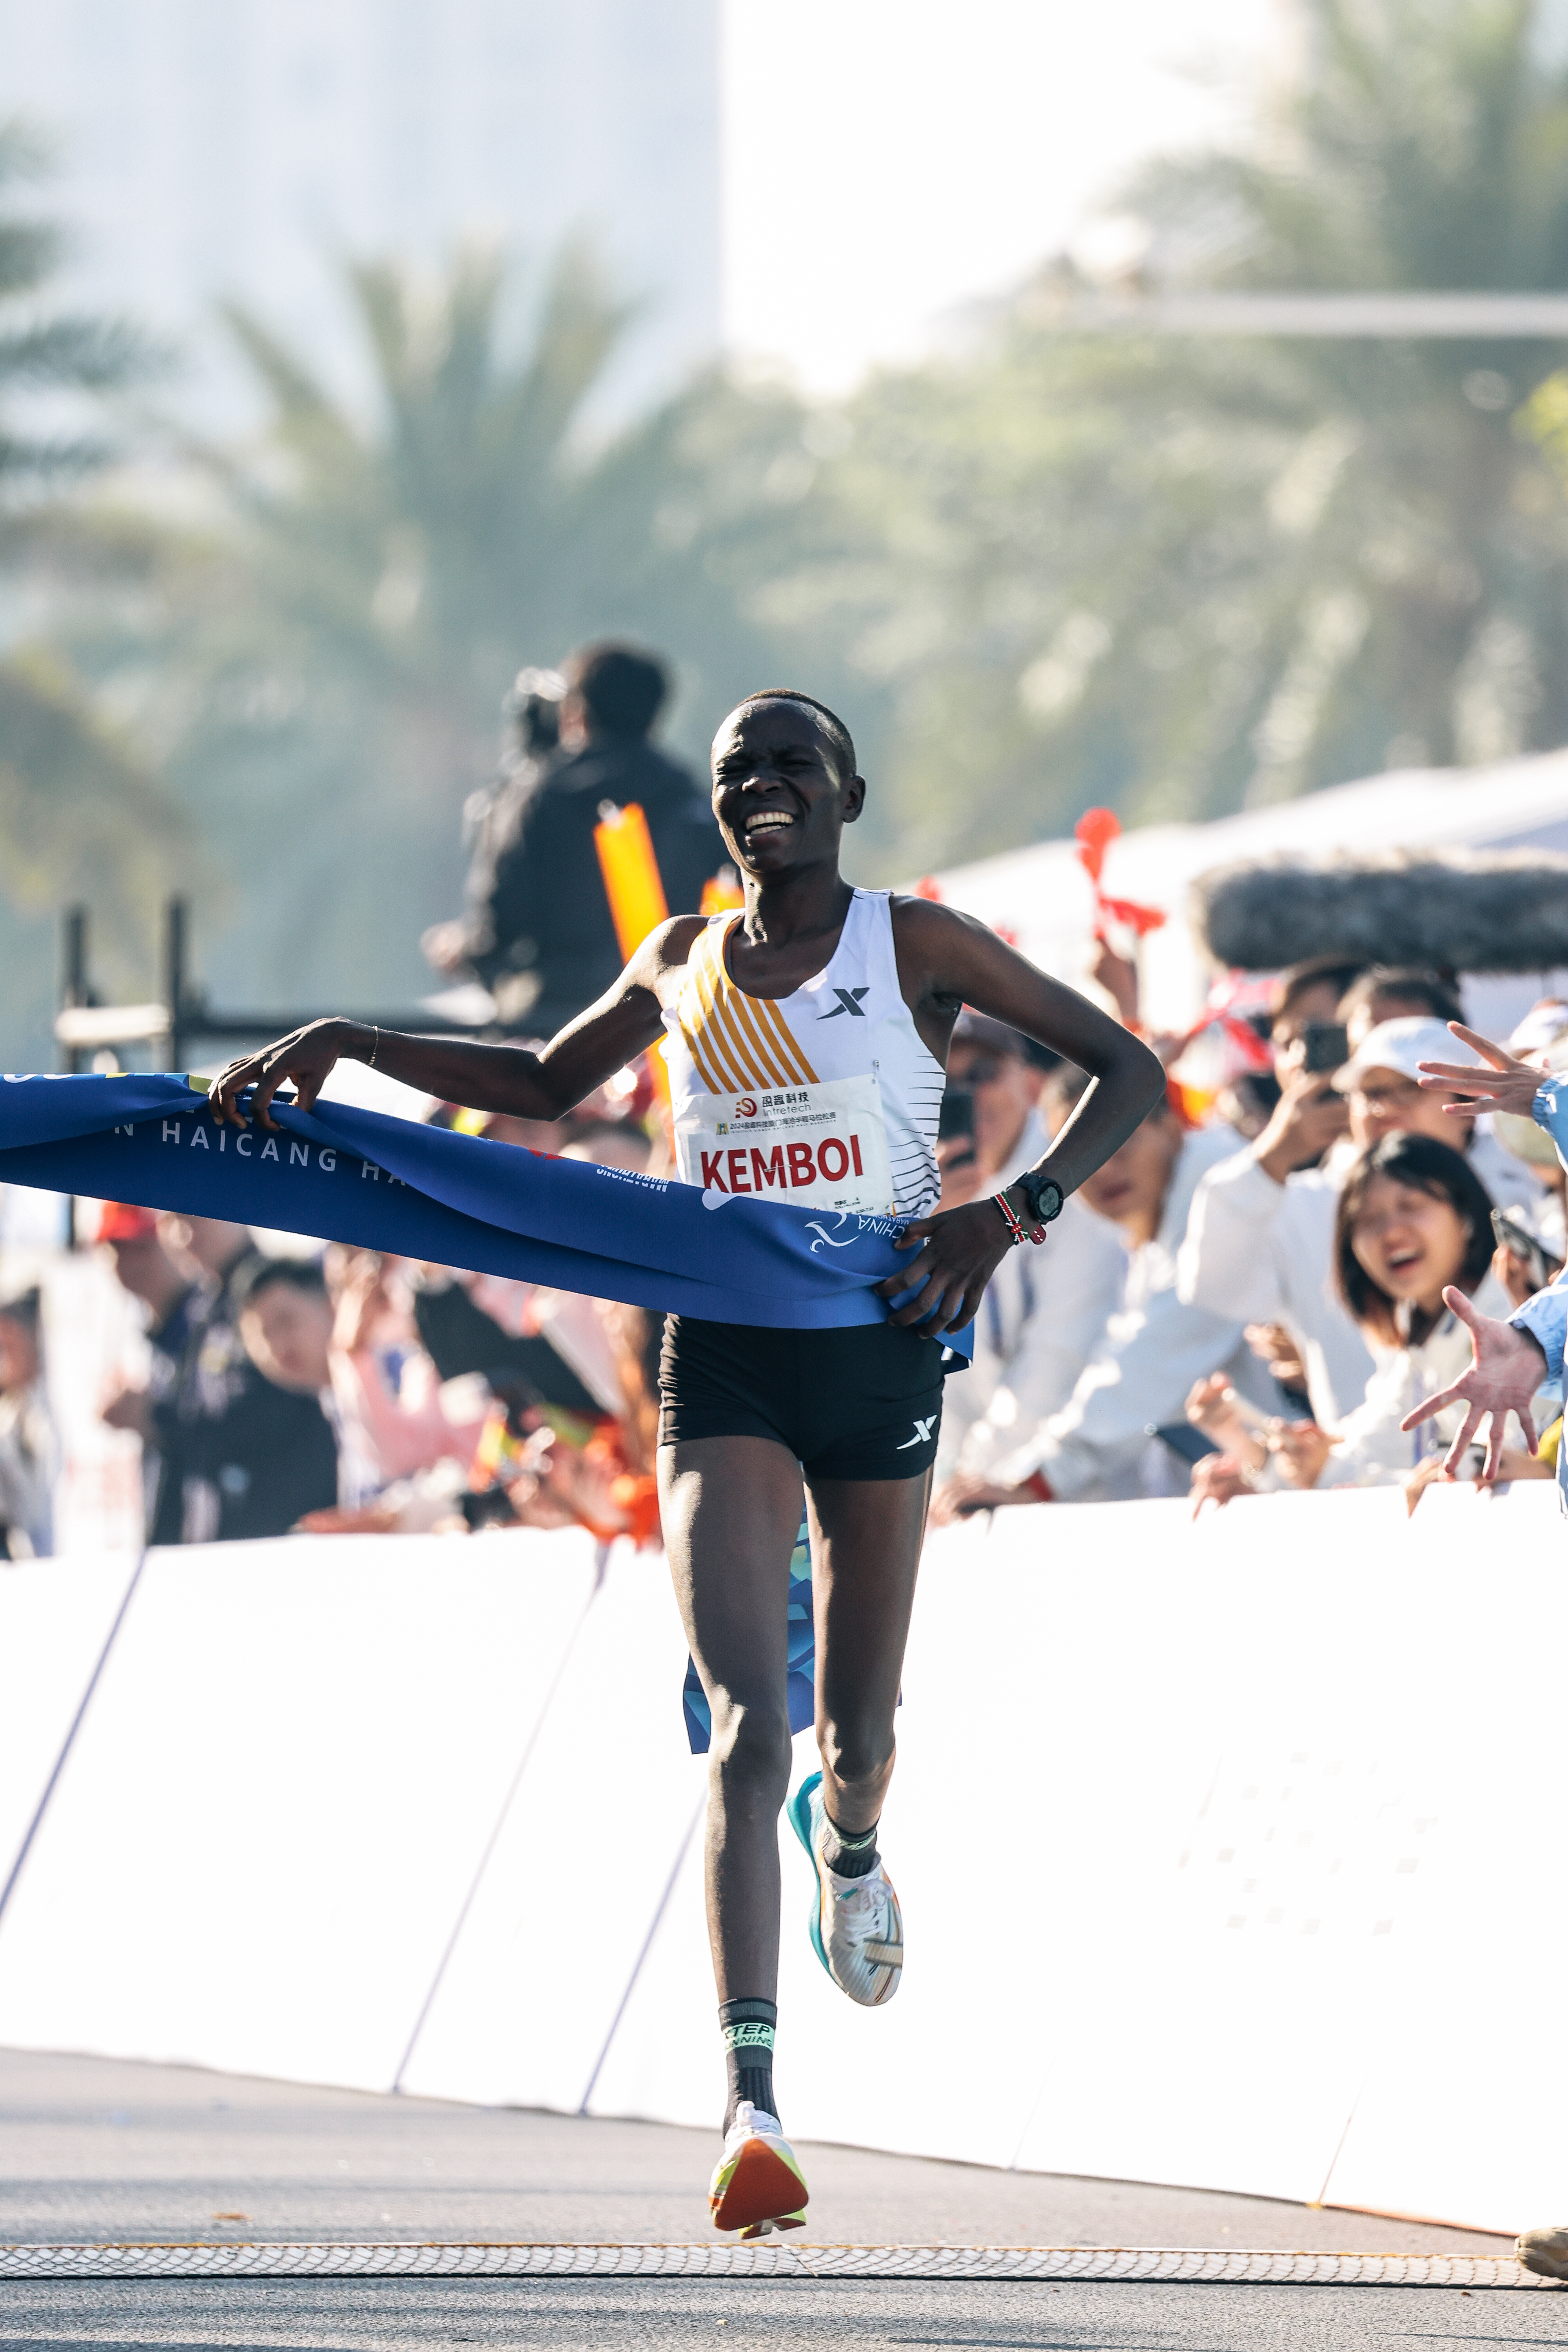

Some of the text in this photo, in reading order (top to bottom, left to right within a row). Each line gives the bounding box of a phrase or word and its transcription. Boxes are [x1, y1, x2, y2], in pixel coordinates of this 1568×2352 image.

[763, 1102, 811, 1116] Intretech
[162, 1120, 337, 1172] HAICANG
[701, 1134, 864, 1194] KEMBOI
[858, 1215, 906, 1239] CHINA
